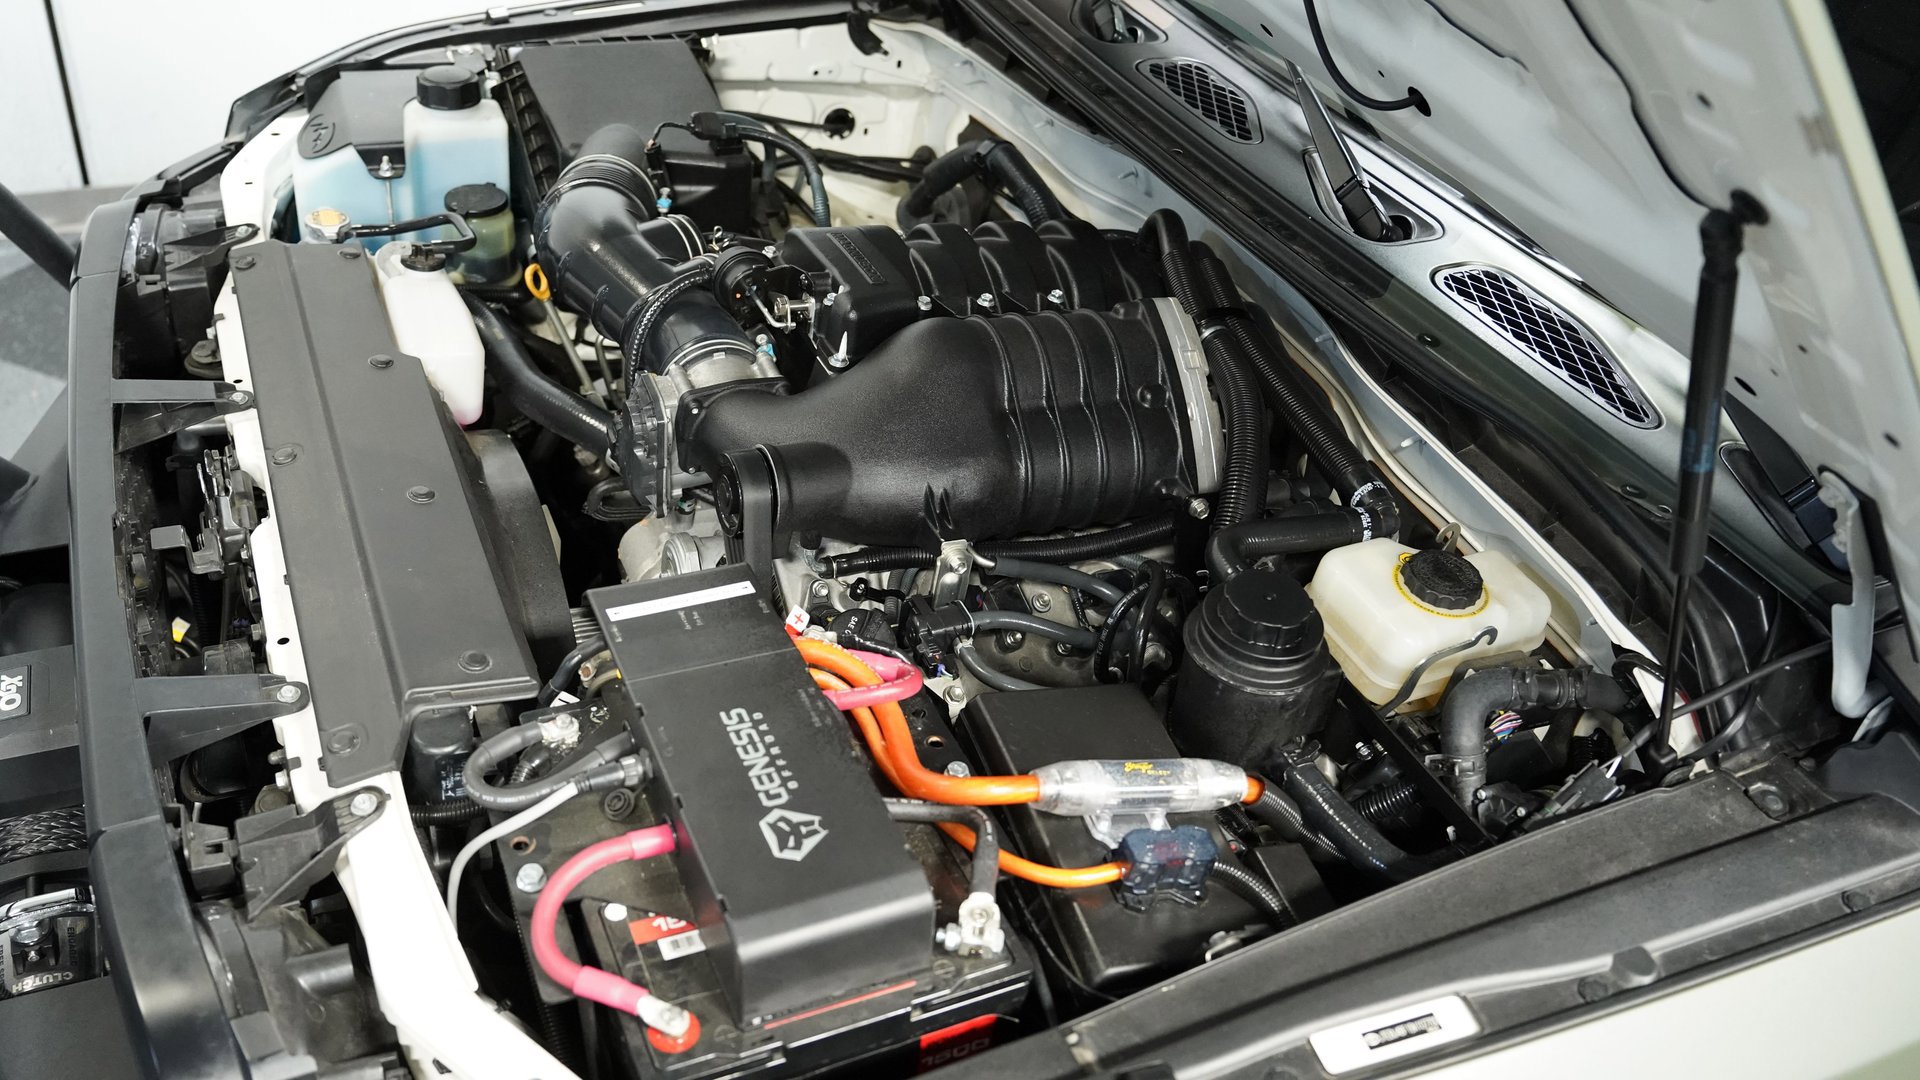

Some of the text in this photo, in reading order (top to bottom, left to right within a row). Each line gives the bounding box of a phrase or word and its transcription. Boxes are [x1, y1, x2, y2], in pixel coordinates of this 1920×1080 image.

[848, 616, 858, 630] SAE
[719, 707, 789, 807] GENESIS
[752, 711, 799, 790] OFFROAD
[12, 972, 73, 993] CLUTCH
